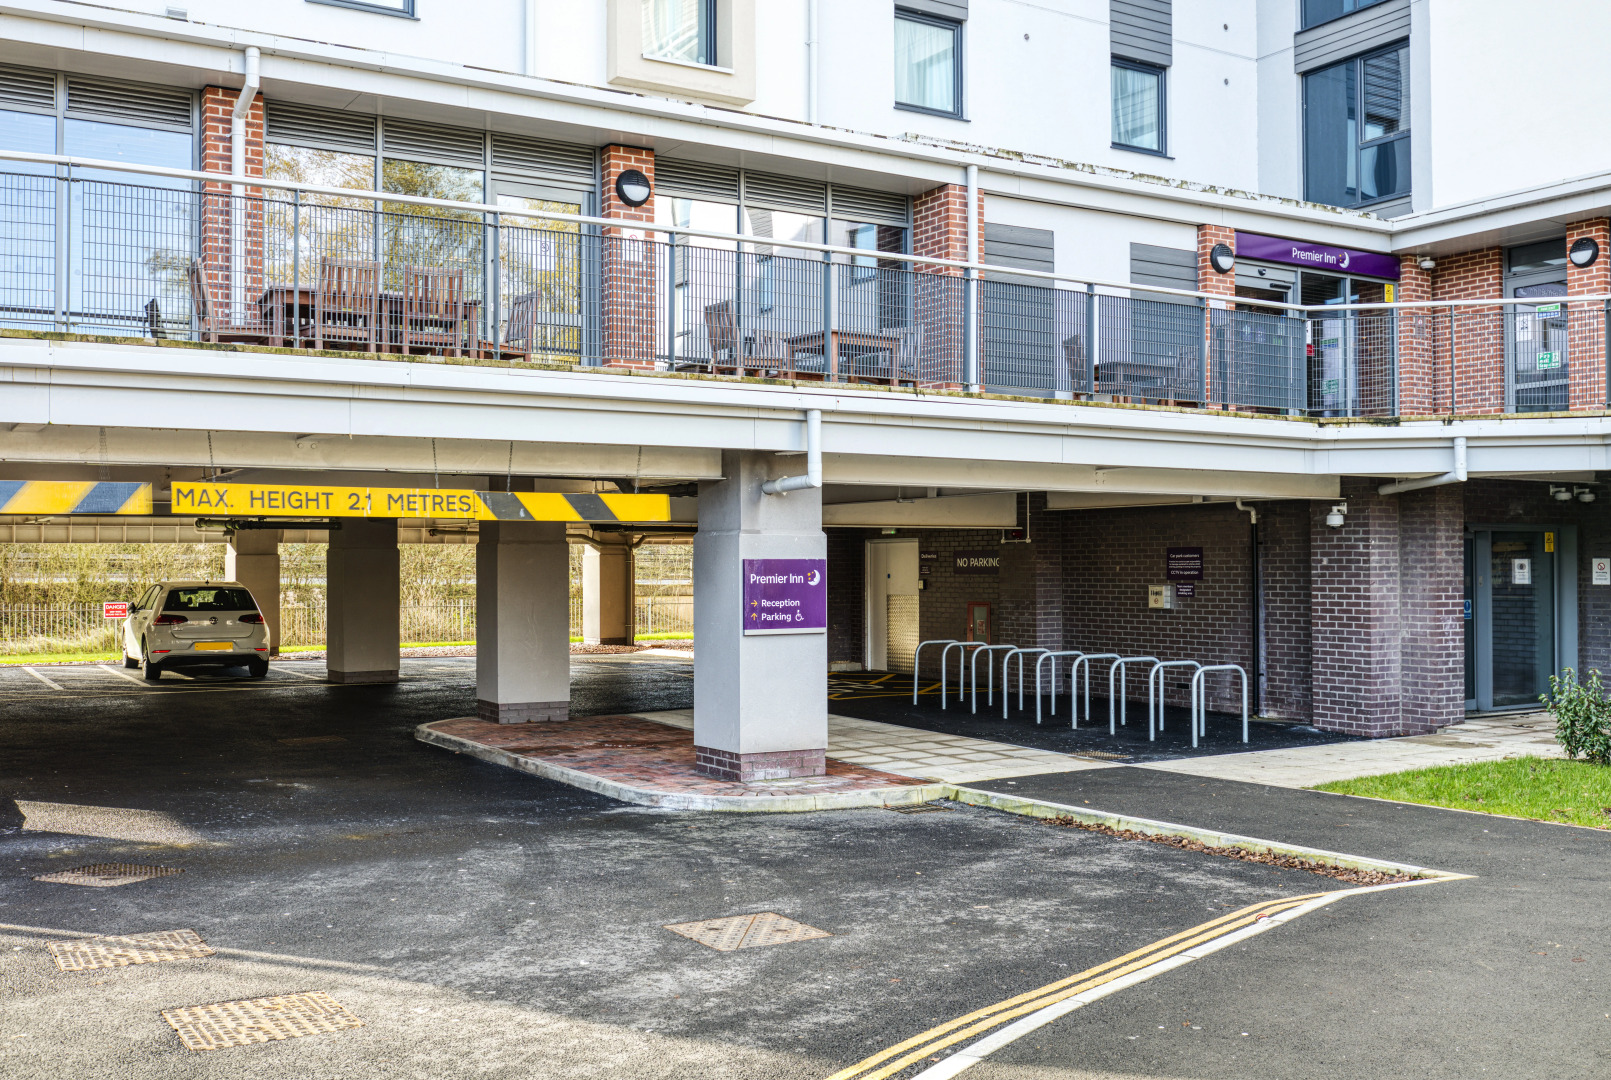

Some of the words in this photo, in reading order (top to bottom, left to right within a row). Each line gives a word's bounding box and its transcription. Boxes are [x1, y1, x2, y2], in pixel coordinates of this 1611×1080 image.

[1292, 247, 1323, 262] Premier
[1324, 252, 1337, 264] Inn
[176, 488, 234, 508] MAX.
[250, 490, 334, 511] HEIGHT
[388, 493, 471, 513] METRES
[956, 558, 968, 567] NO
[750, 574, 788, 584] Premier
[790, 573, 804, 583] Inn
[761, 599, 800, 608] Reception
[761, 612, 792, 622] Parking
